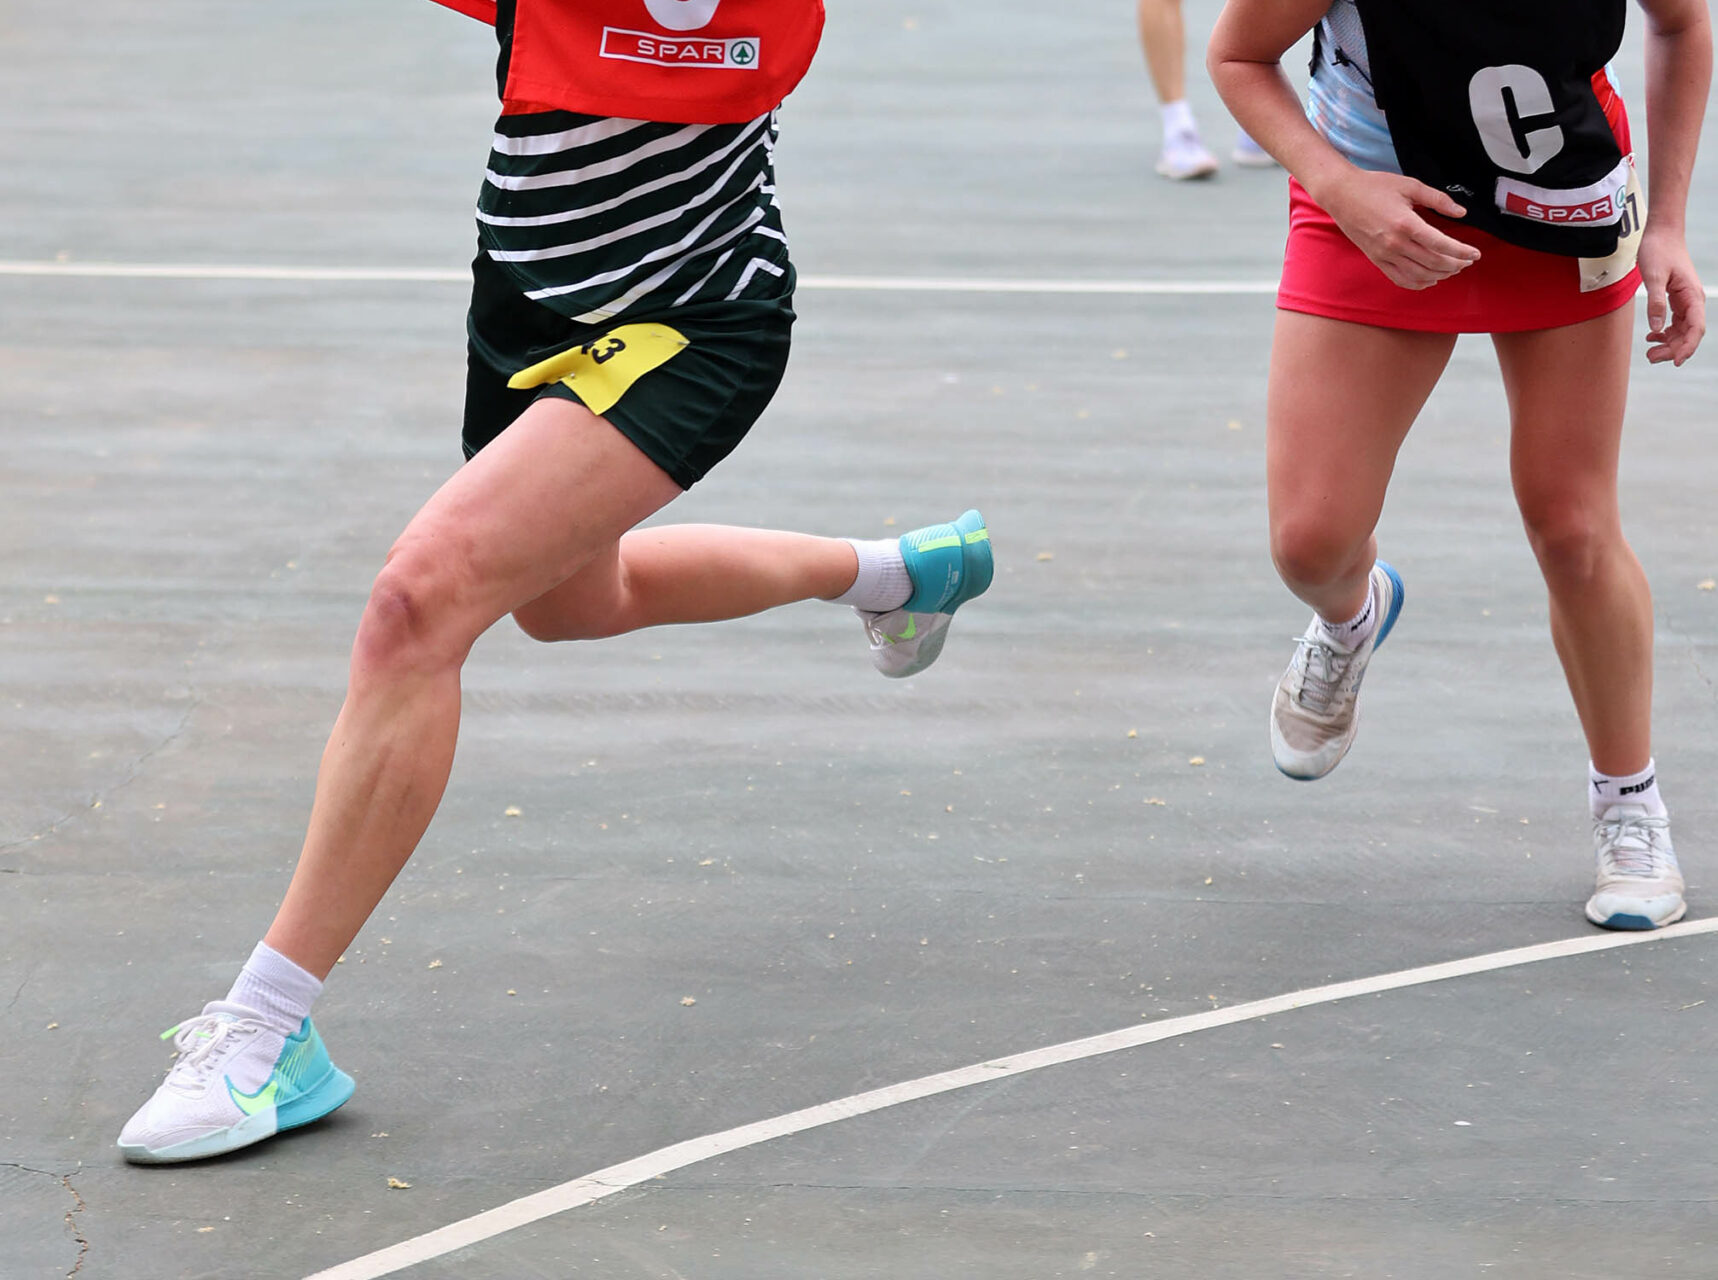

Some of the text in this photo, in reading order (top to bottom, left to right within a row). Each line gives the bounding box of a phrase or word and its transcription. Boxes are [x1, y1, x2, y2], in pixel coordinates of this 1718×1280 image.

[637, 39, 723, 60] SPAR
[1469, 64, 1564, 174] C
[1526, 199, 1612, 221] SPAR
[581, 338, 626, 365] 3
